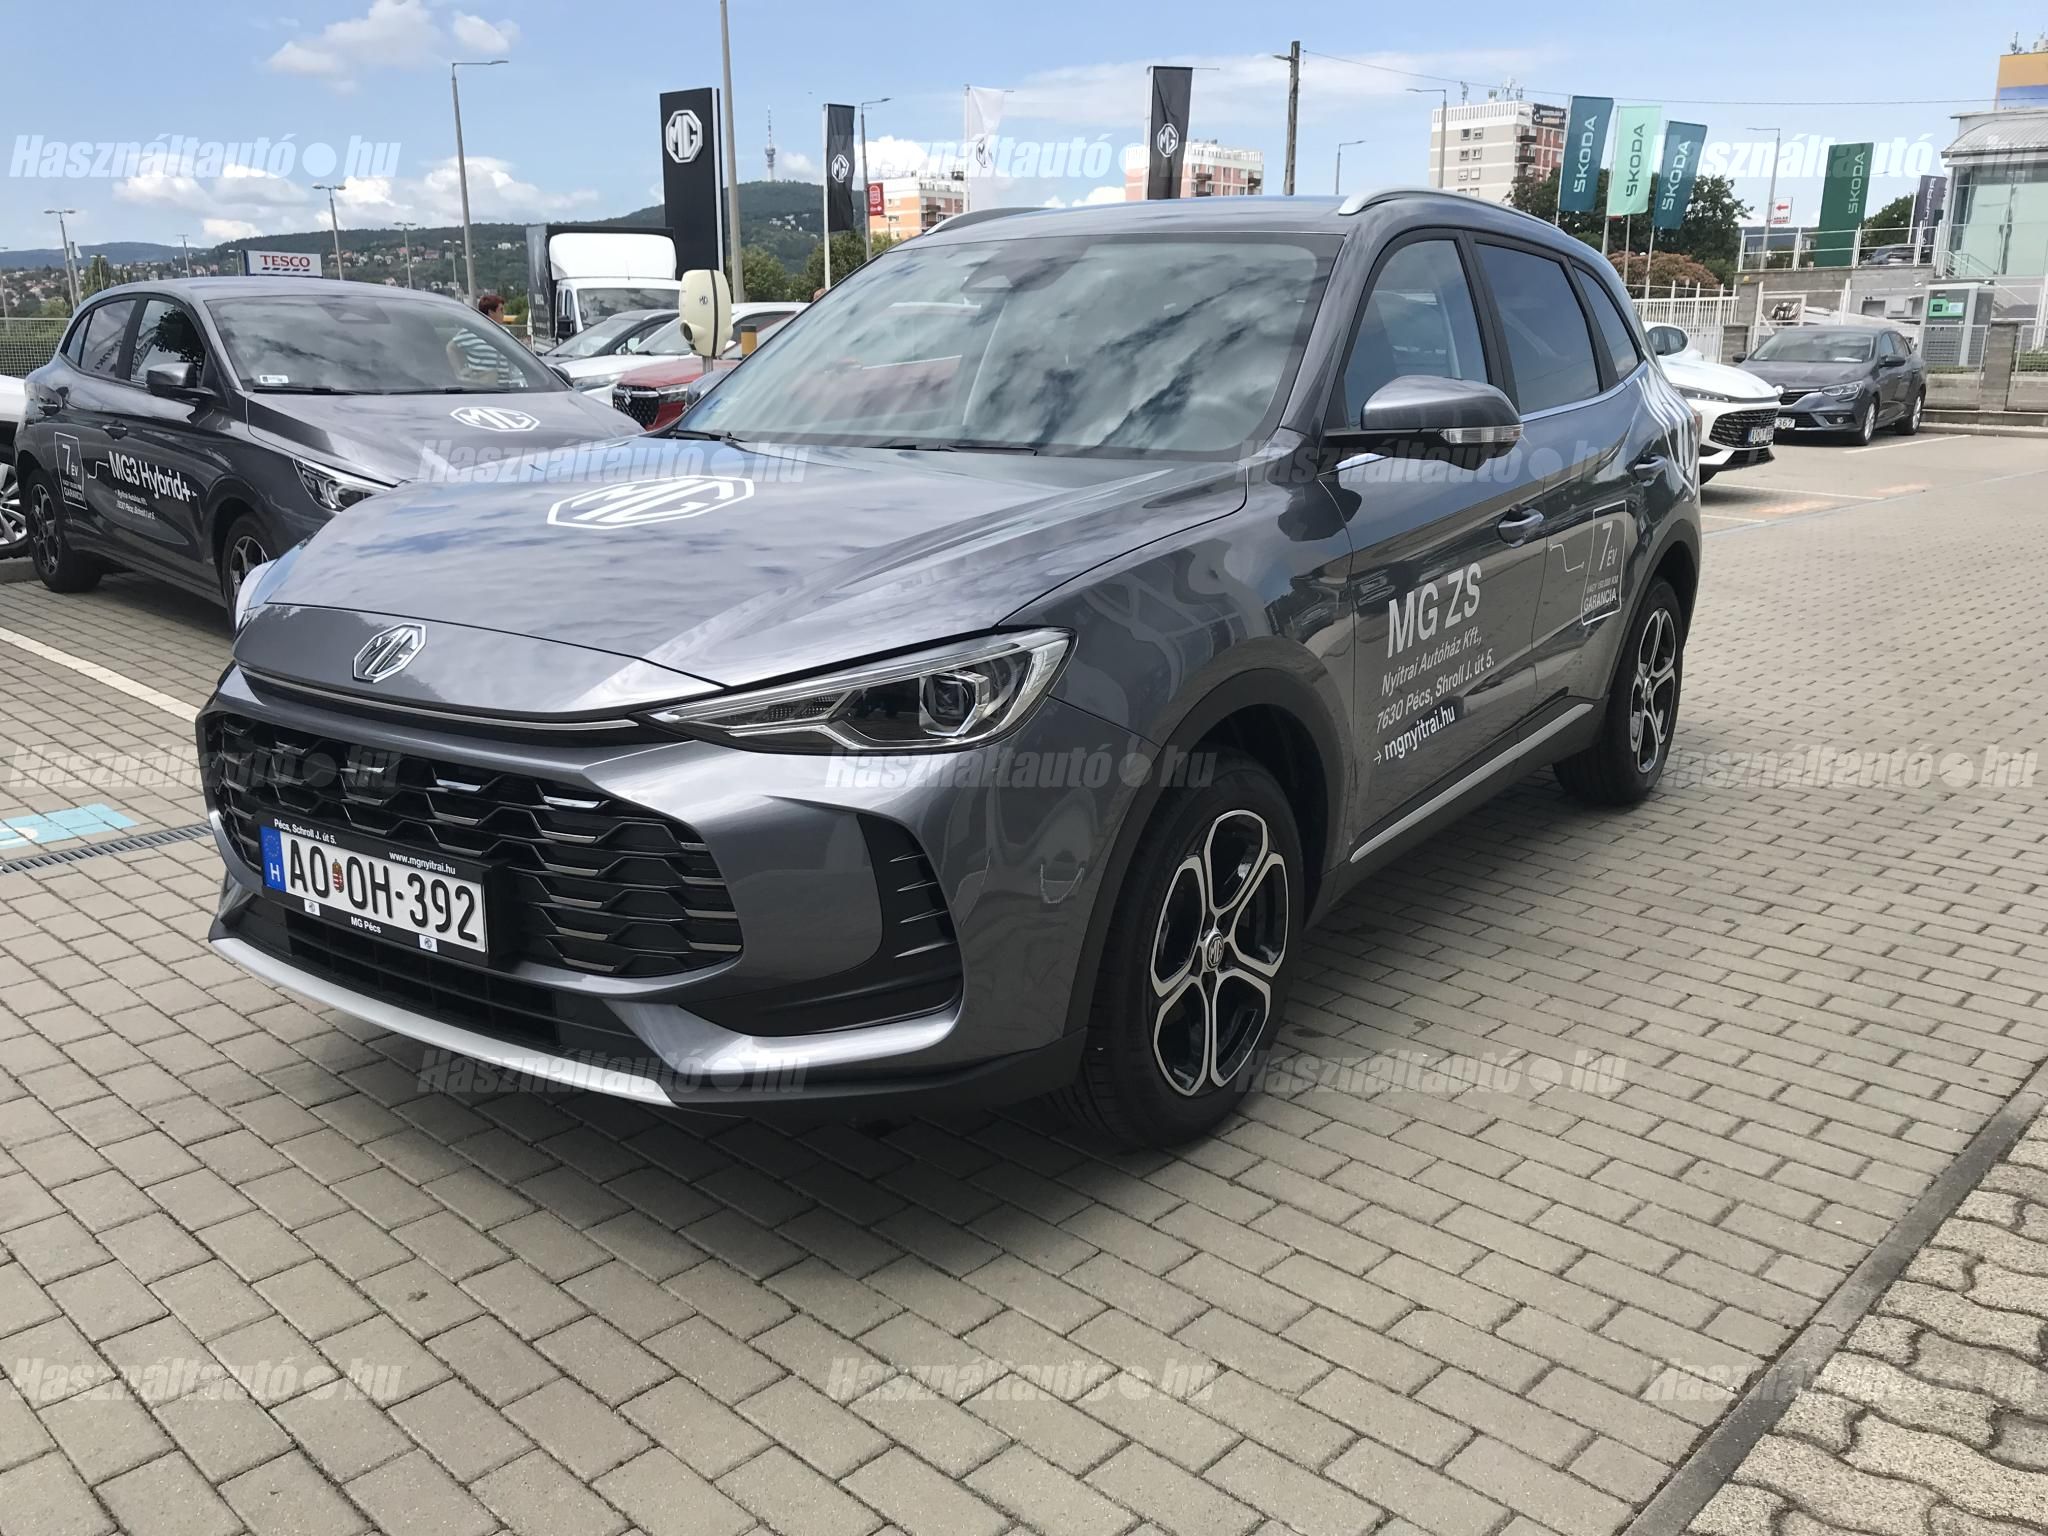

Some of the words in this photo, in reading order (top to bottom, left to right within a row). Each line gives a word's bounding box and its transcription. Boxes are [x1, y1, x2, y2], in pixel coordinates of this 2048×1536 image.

[667, 113, 700, 159] MG
[259, 254, 311, 269] TESCO
[457, 408, 534, 430] MG
[62, 444, 71, 475] 7
[108, 450, 140, 486] MG3
[138, 460, 191, 502] Hybrid+
[568, 477, 738, 524] MG
[1598, 520, 1613, 571] 7
[1606, 545, 1618, 567] ÉV
[1387, 582, 1439, 659] MG
[1445, 562, 1481, 629] ZS
[1583, 587, 1617, 612] GARANCIA
[360, 627, 419, 677] MG
[1382, 656, 1419, 697] Nyitrai
[1418, 636, 1461, 675] Autóház
[1377, 698, 1404, 734] 7630
[1405, 688, 1433, 715] Pécs,
[1435, 663, 1465, 698] Shroll
[1465, 660, 1473, 681] J.
[1474, 653, 1485, 675] út
[1486, 647, 1495, 668] 5.
[1384, 705, 1456, 760] mgnyitrai.hu
[291, 823, 315, 838] Schroll
[269, 862, 281, 882] H
[389, 851, 456, 875] www.mgnyitrai.hu
[346, 855, 478, 943] OH-392
[350, 915, 363, 928] MG
[363, 920, 382, 934] Pécs
